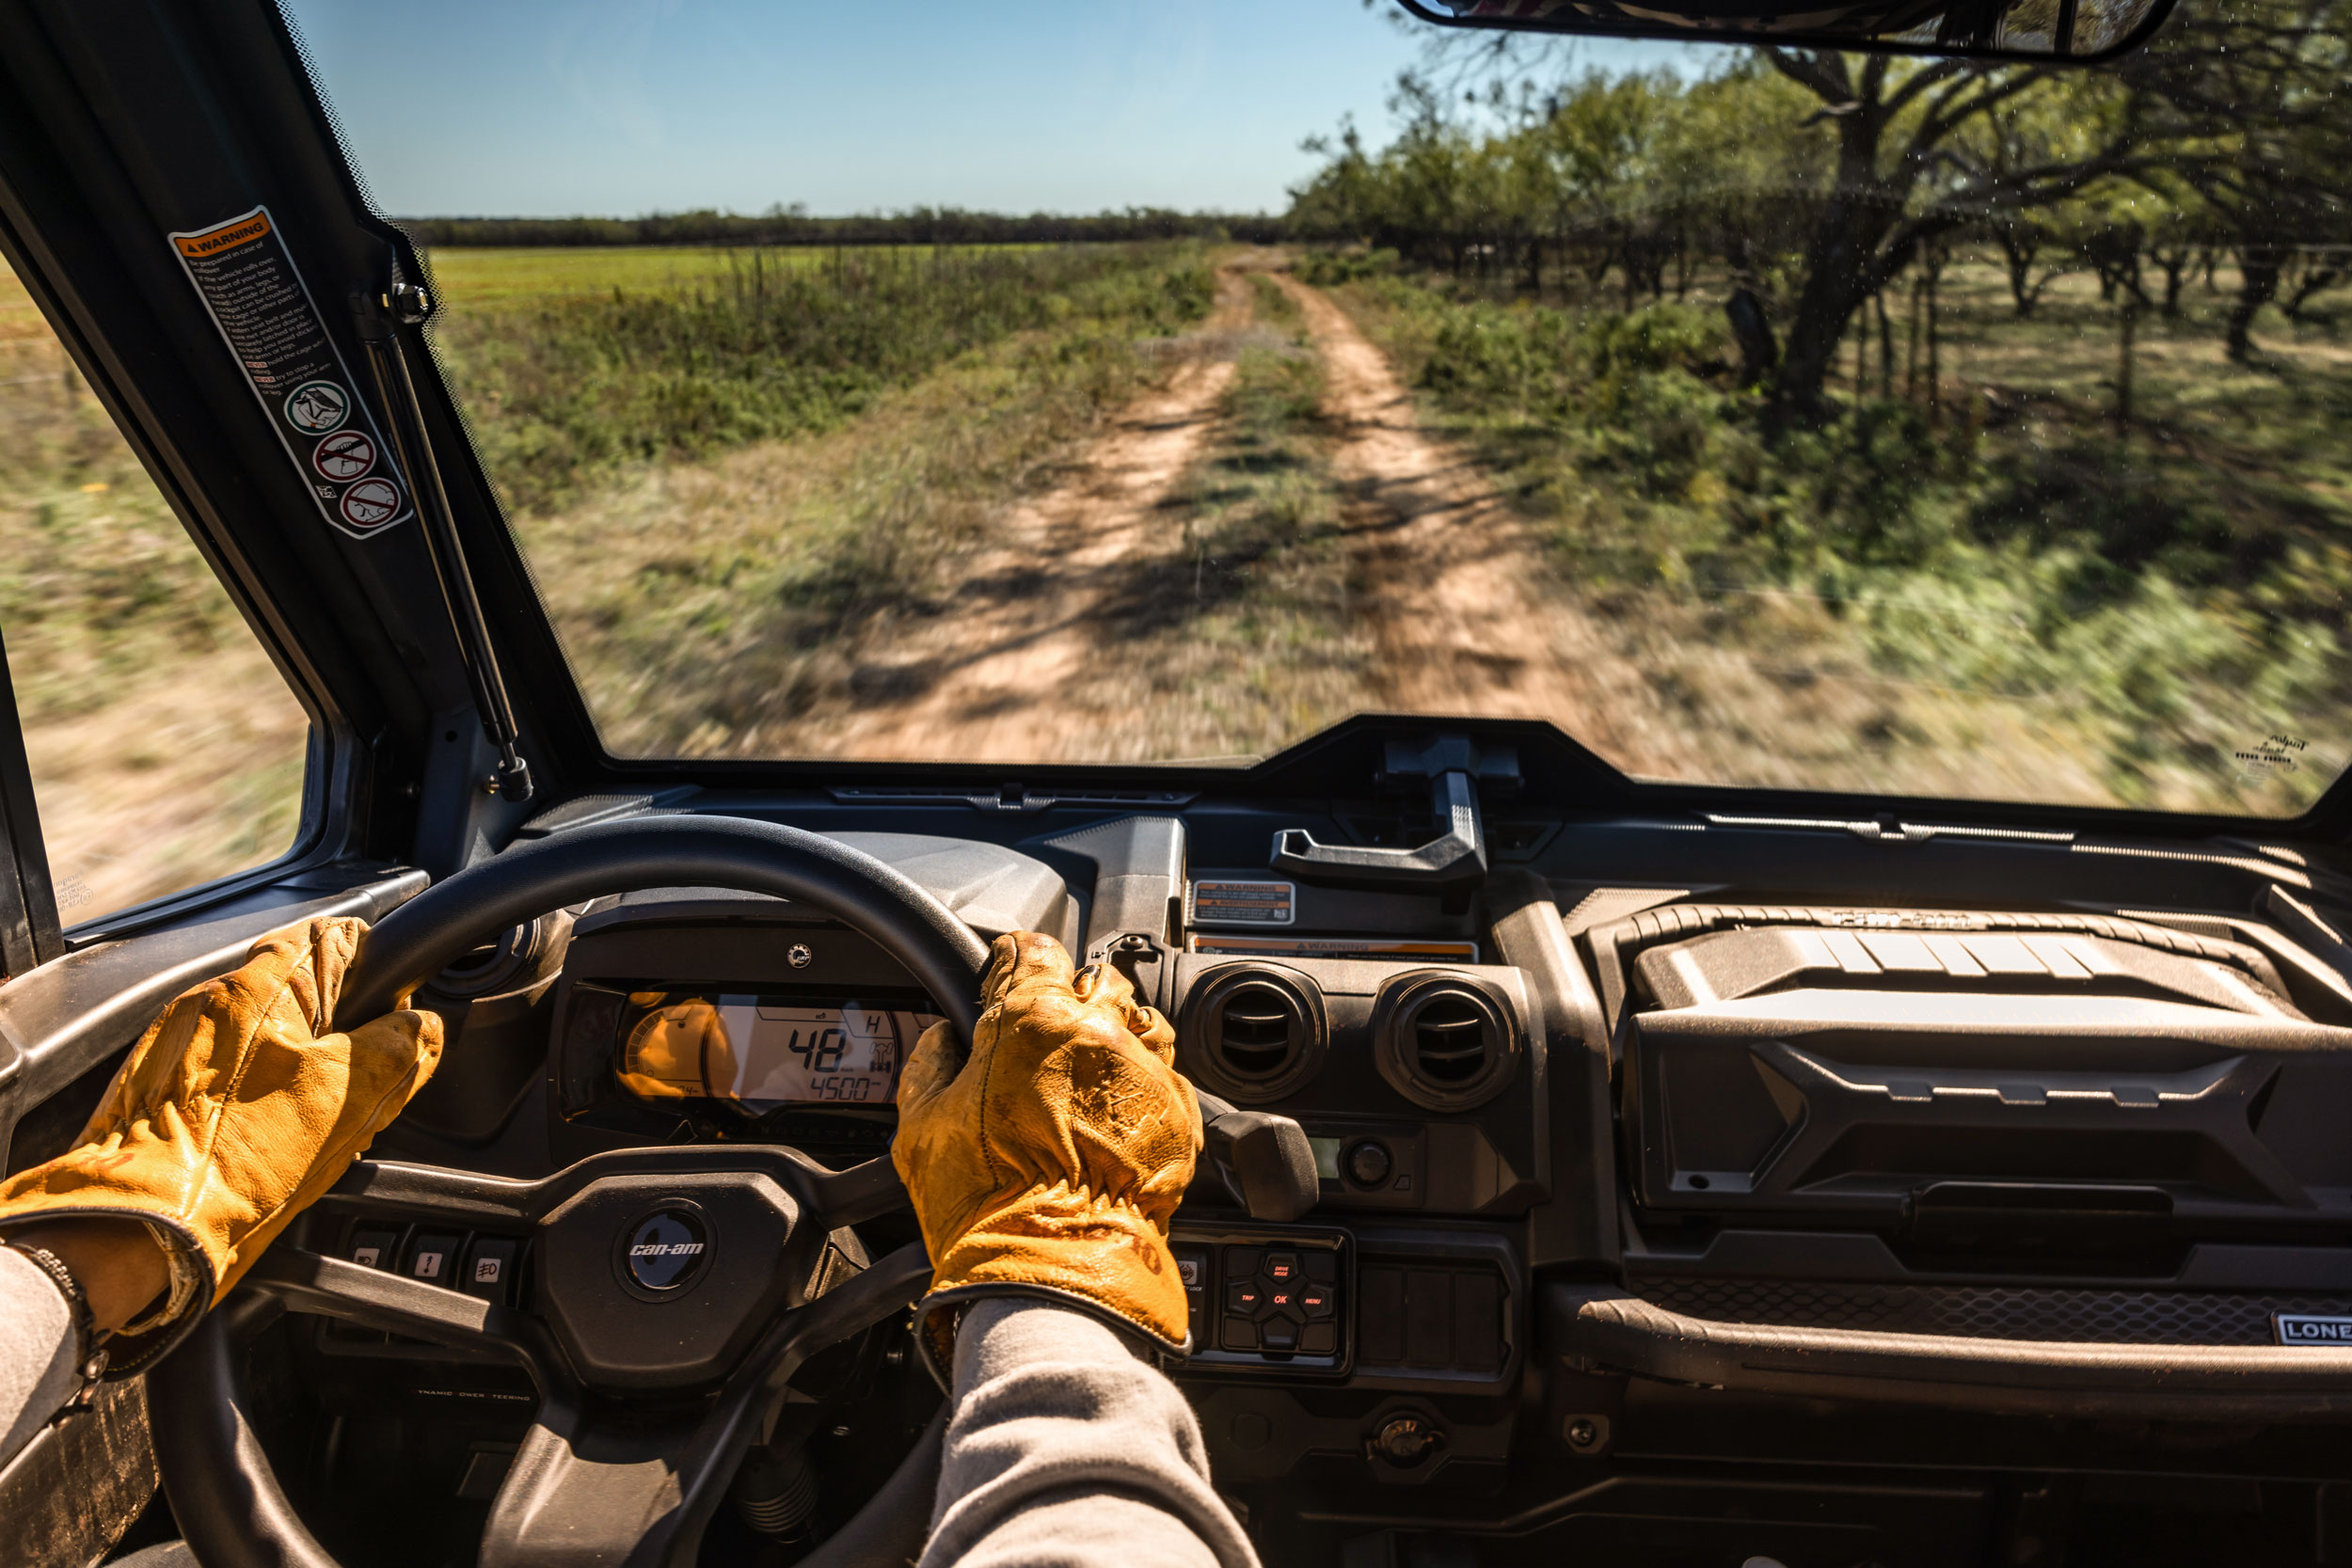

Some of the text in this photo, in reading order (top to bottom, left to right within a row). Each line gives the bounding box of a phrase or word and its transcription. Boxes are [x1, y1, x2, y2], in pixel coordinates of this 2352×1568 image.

[198, 222, 263, 252] WARNING
[199, 253, 232, 267] prepared
[240, 245, 255, 255] case
[255, 241, 263, 249] of
[217, 269, 242, 281] vehicle
[243, 263, 258, 272] rolls
[258, 257, 277, 267] over,
[217, 283, 232, 292] part
[241, 274, 257, 285] your
[257, 267, 275, 277] body
[236, 285, 256, 294] arms,
[256, 279, 273, 287] legs,
[232, 292, 258, 304] outside
[265, 285, 292, 301] crushed
[258, 301, 277, 311] other
[277, 294, 295, 304] parts
[250, 322, 265, 330] seat
[265, 316, 280, 325] belt
[280, 310, 294, 319] and
[259, 324, 282, 335] and/or
[282, 318, 299, 326] door
[263, 329, 288, 341] latched
[277, 333, 295, 344] avoid
[268, 356, 284, 365] hold
[296, 346, 312, 355] cage
[284, 375, 304, 385] using
[303, 369, 318, 378] your
[318, 363, 331, 371] arm
[294, 364, 309, 373] stop
[1308, 942, 1368, 951] WARNING
[865, 1016, 881, 1033] H
[788, 1028, 847, 1073] 48
[810, 1077, 870, 1101] 4500
[629, 1243, 704, 1255] can-am
[1274, 1295, 1287, 1304] OK
